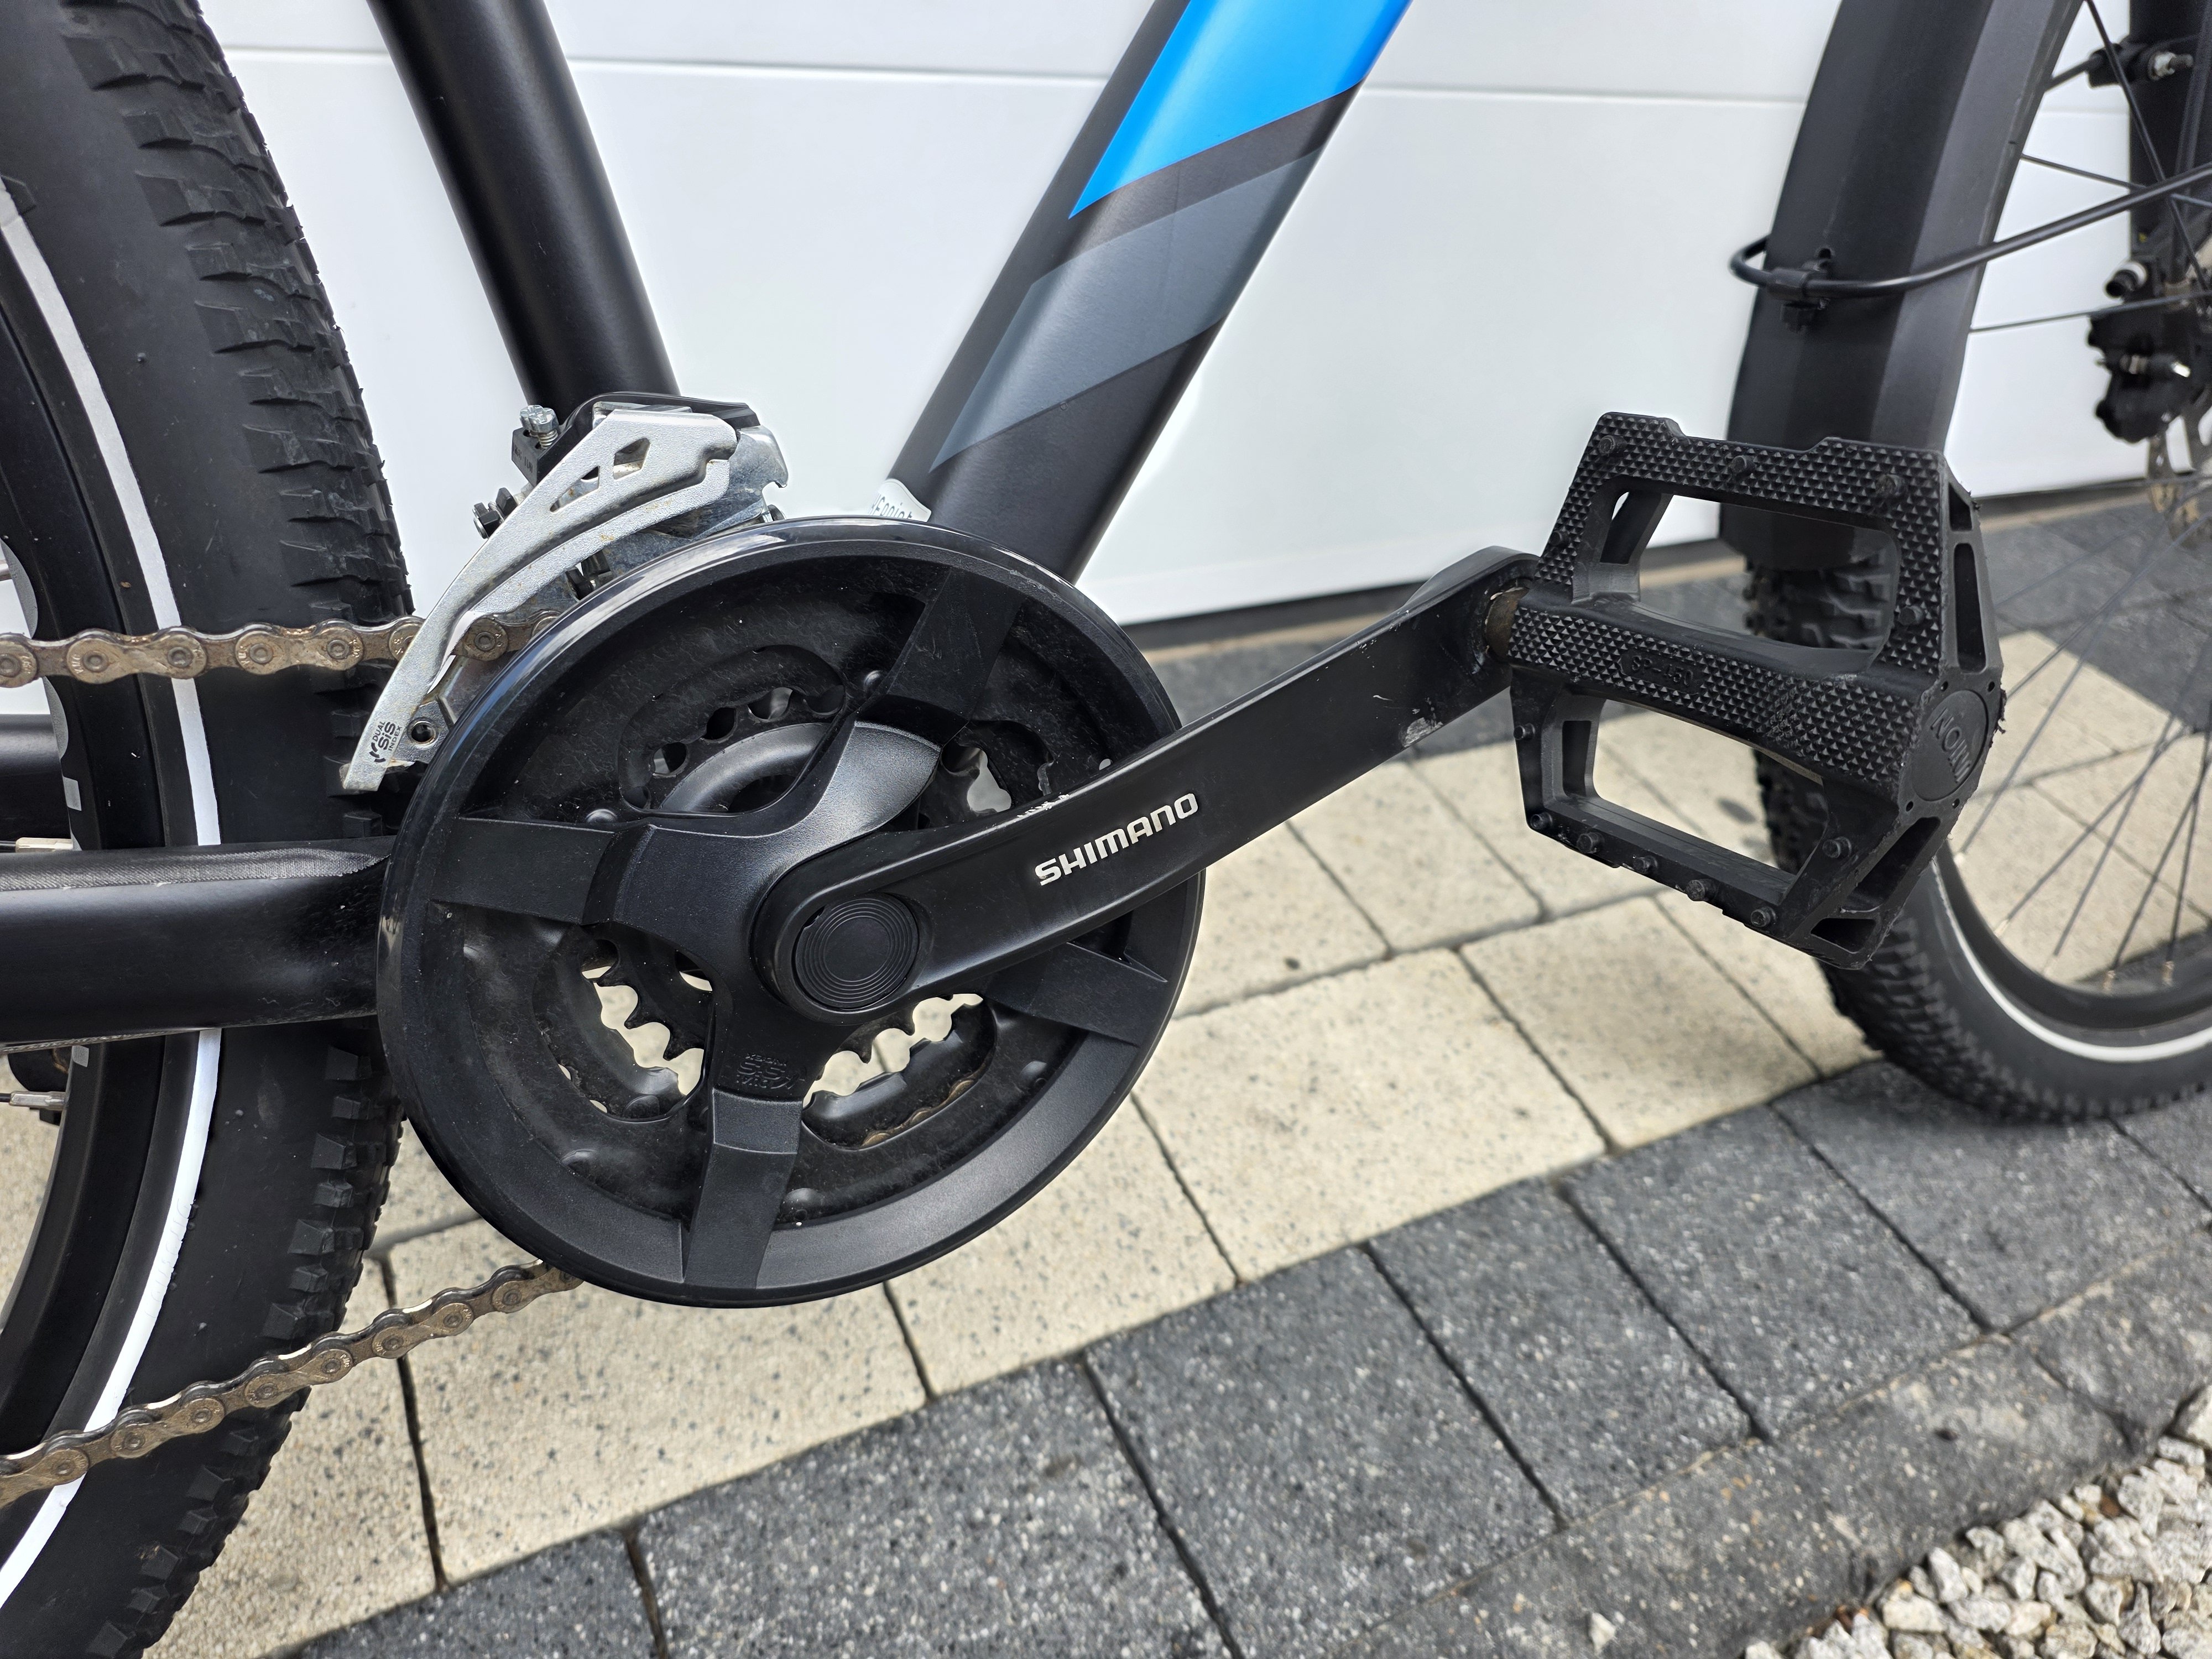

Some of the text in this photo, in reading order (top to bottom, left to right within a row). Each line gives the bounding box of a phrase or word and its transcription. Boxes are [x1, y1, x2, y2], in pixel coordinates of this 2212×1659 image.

[372, 721, 386, 742] DUAL
[388, 726, 403, 751] INDEX
[1035, 793, 1199, 886] SHIMANO
